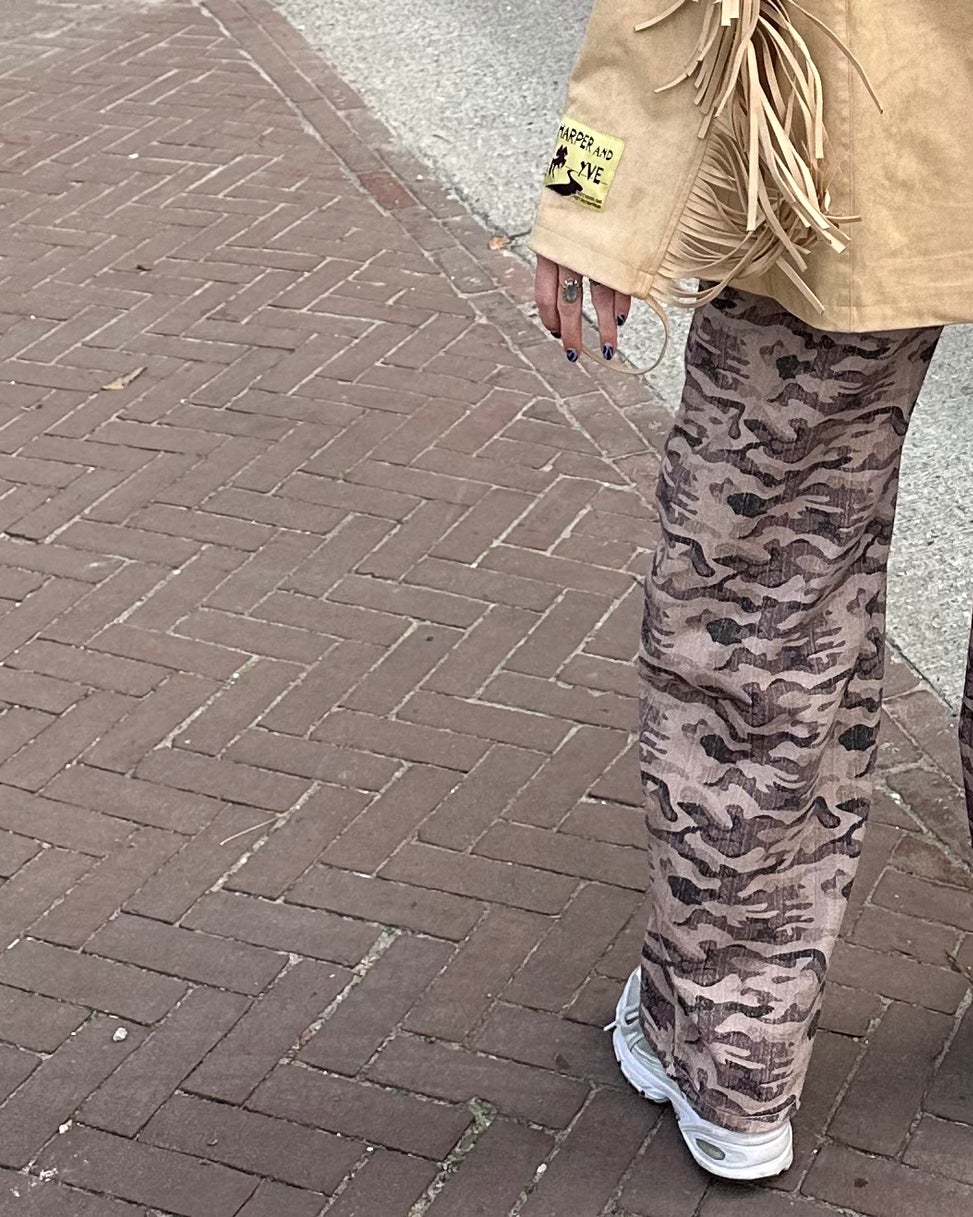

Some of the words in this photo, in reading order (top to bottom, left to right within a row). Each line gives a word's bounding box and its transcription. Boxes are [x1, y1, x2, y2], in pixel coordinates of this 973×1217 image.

[559, 124, 595, 153] HARPER
[592, 146, 614, 161] AND
[577, 160, 605, 185] YVE
